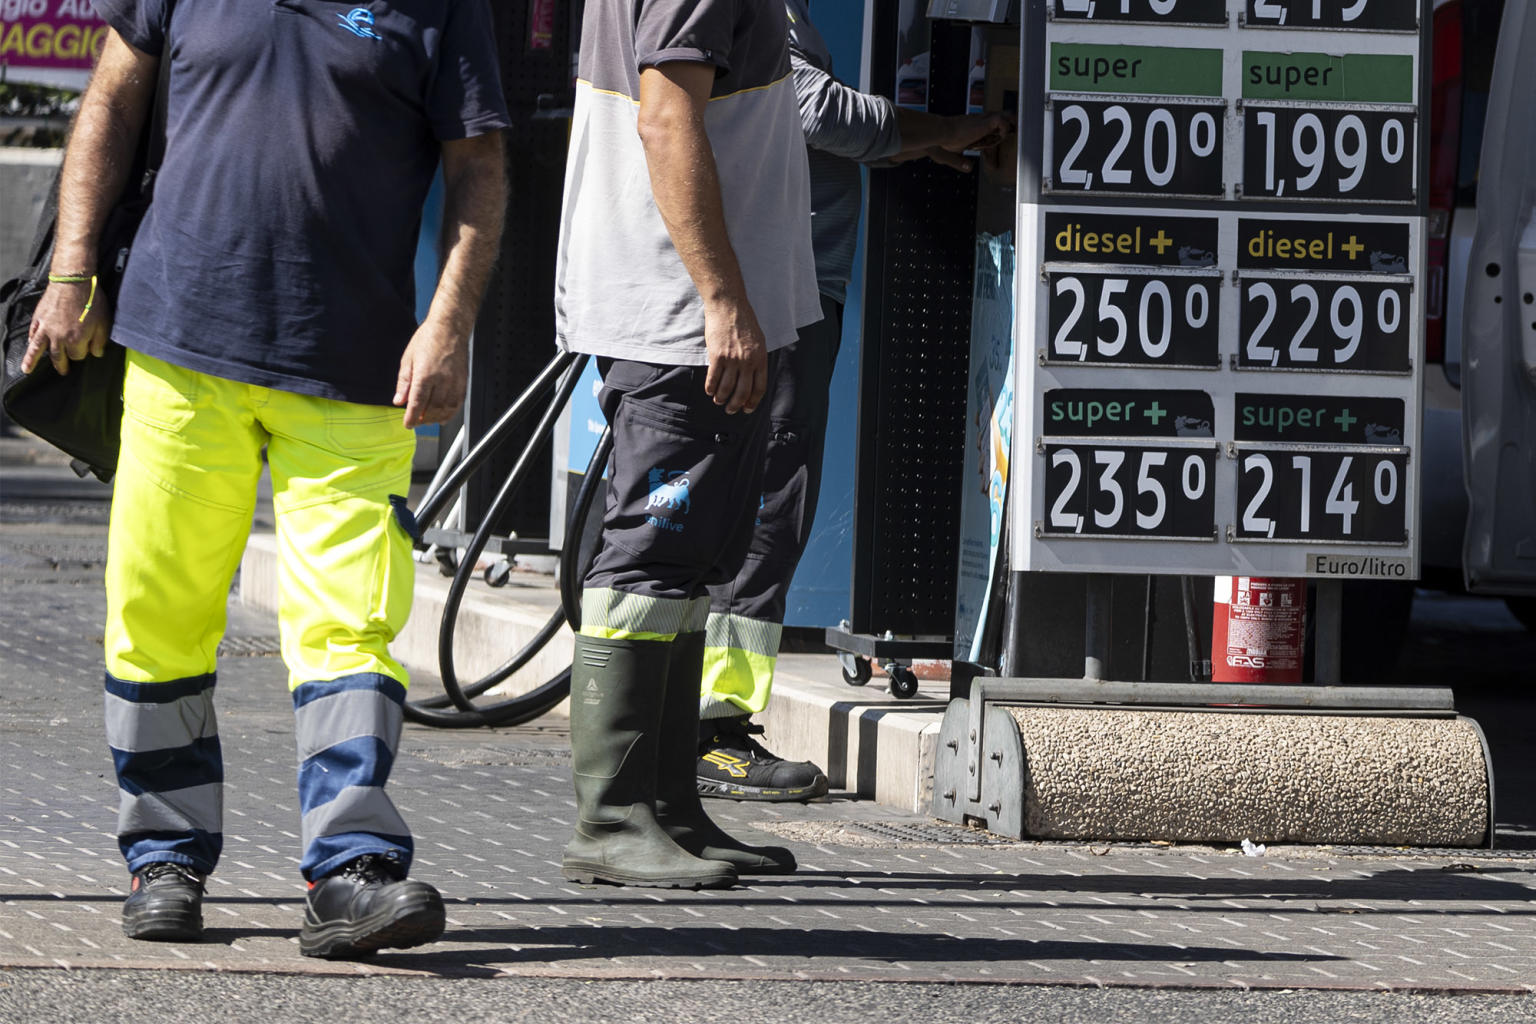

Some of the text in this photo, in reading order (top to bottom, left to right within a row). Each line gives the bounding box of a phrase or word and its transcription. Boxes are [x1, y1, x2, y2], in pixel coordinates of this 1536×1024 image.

[1058, 55, 1142, 84] super
[1249, 62, 1333, 90] super
[1055, 225, 1141, 254] diesel
[1248, 230, 1333, 260] diesel
[1050, 397, 1136, 425] super
[1241, 406, 1327, 431] super
[1315, 556, 1407, 577] Euro/litro
